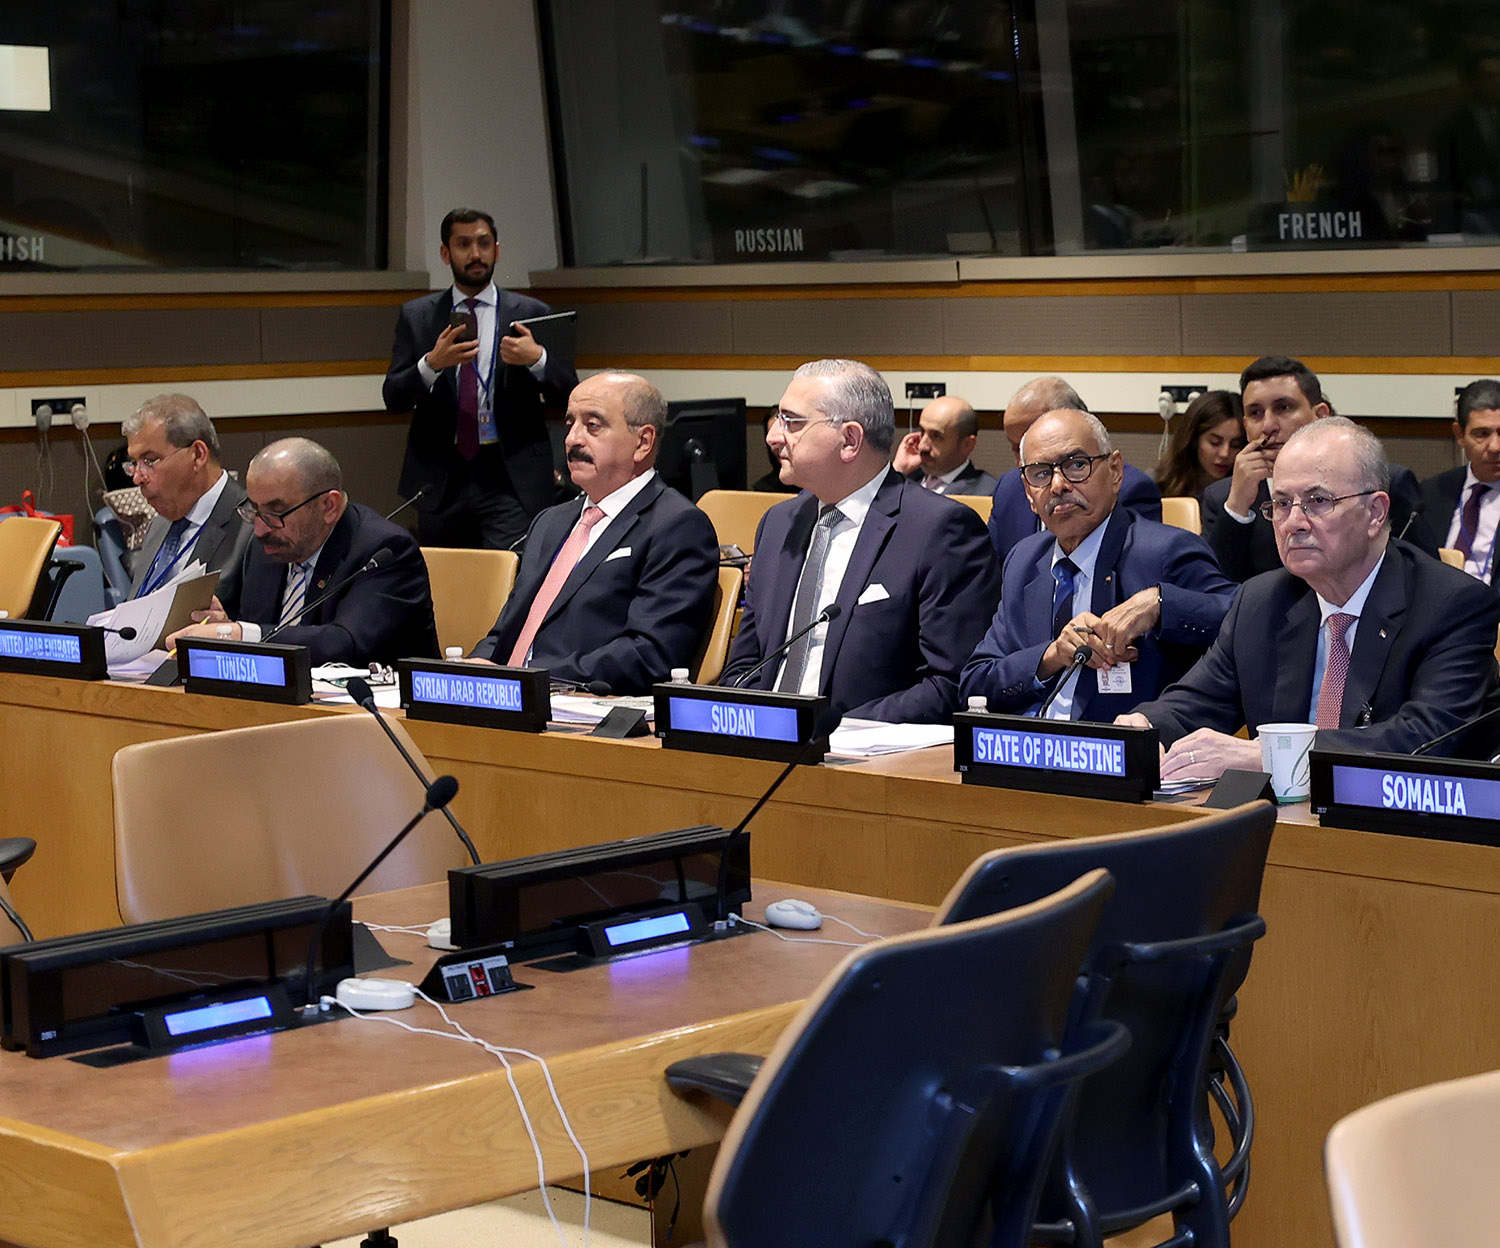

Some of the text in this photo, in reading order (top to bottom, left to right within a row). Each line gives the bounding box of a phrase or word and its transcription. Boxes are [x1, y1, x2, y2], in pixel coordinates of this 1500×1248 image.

[735, 228, 804, 252] RUSSIAN
[1278, 211, 1362, 239] FRENCH
[25, 636, 43, 656] ARAB
[44, 637, 80, 659] EMIRATES
[215, 655, 259, 682] TUNISIA
[414, 676, 521, 708] SYRIAN ARAB REPUBLIC
[711, 704, 756, 737] SUDAN
[977, 731, 1122, 773] STATE OF PALESTINE
[1382, 774, 1467, 815] SOMALIA
